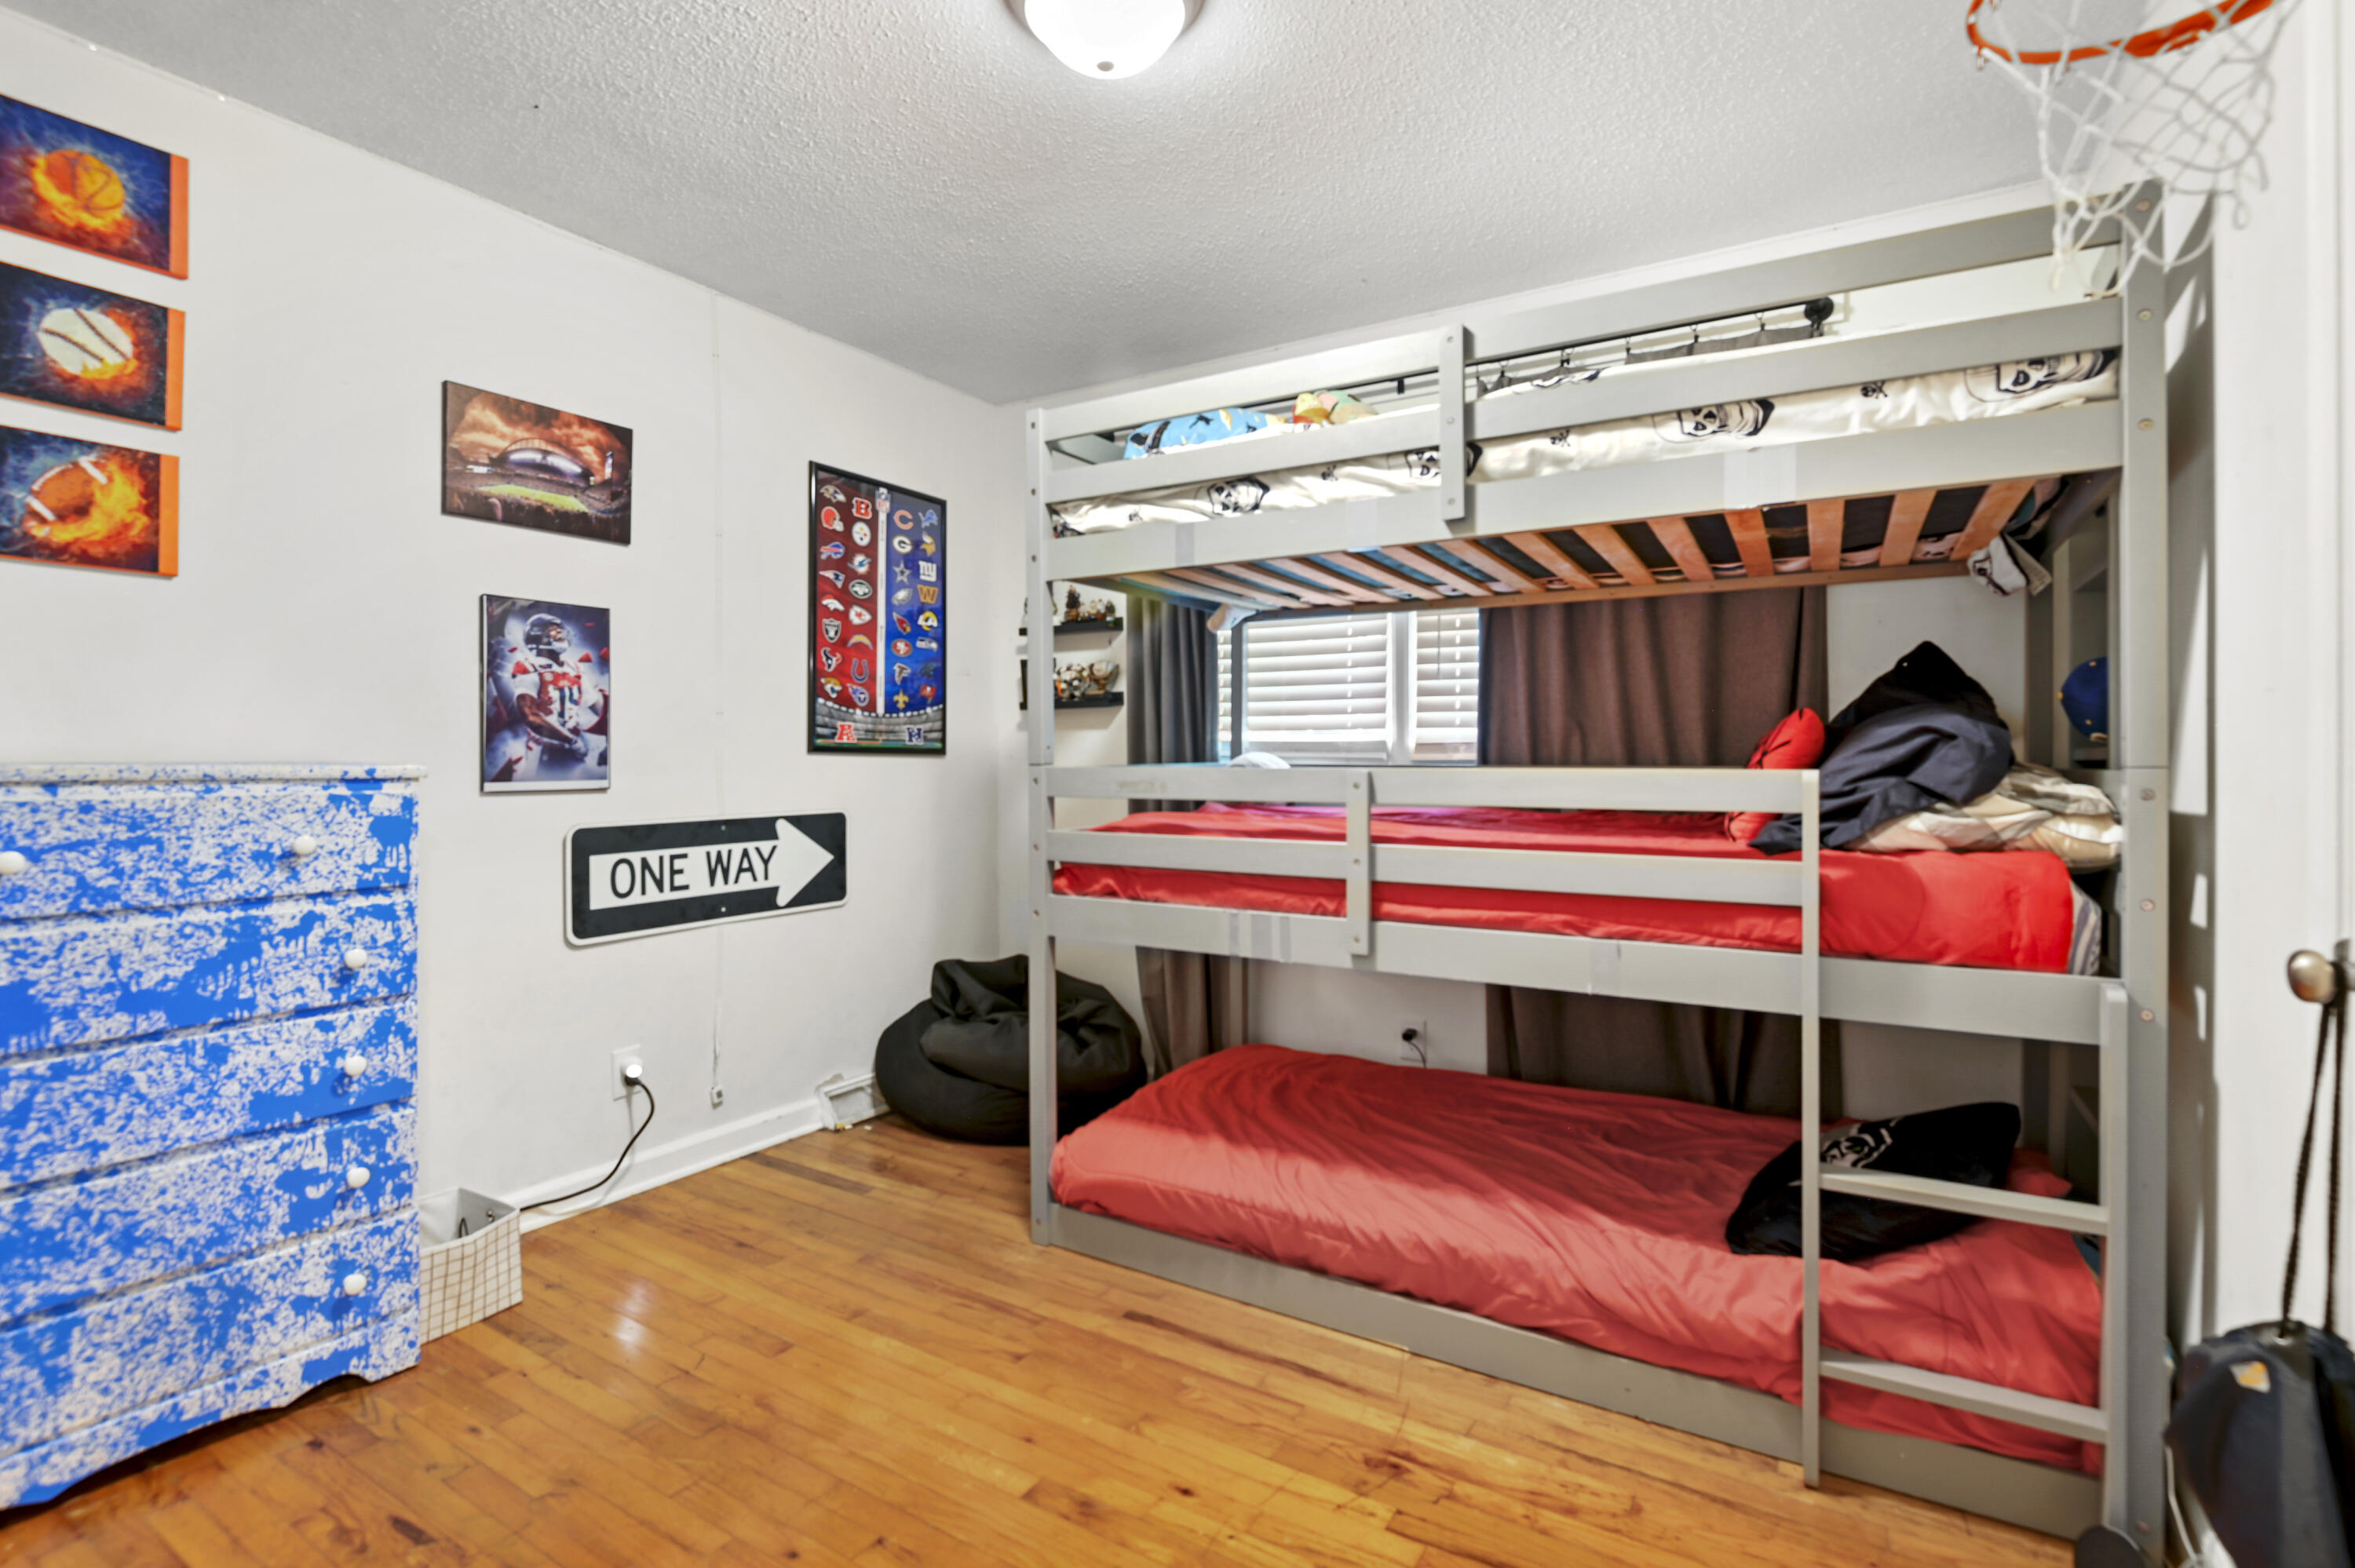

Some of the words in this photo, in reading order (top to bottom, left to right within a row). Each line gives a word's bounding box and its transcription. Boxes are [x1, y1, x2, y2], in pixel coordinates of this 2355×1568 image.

[893, 509, 914, 530] C
[917, 585, 939, 603] W
[610, 853, 690, 899] ONE
[706, 844, 777, 887] WAY
